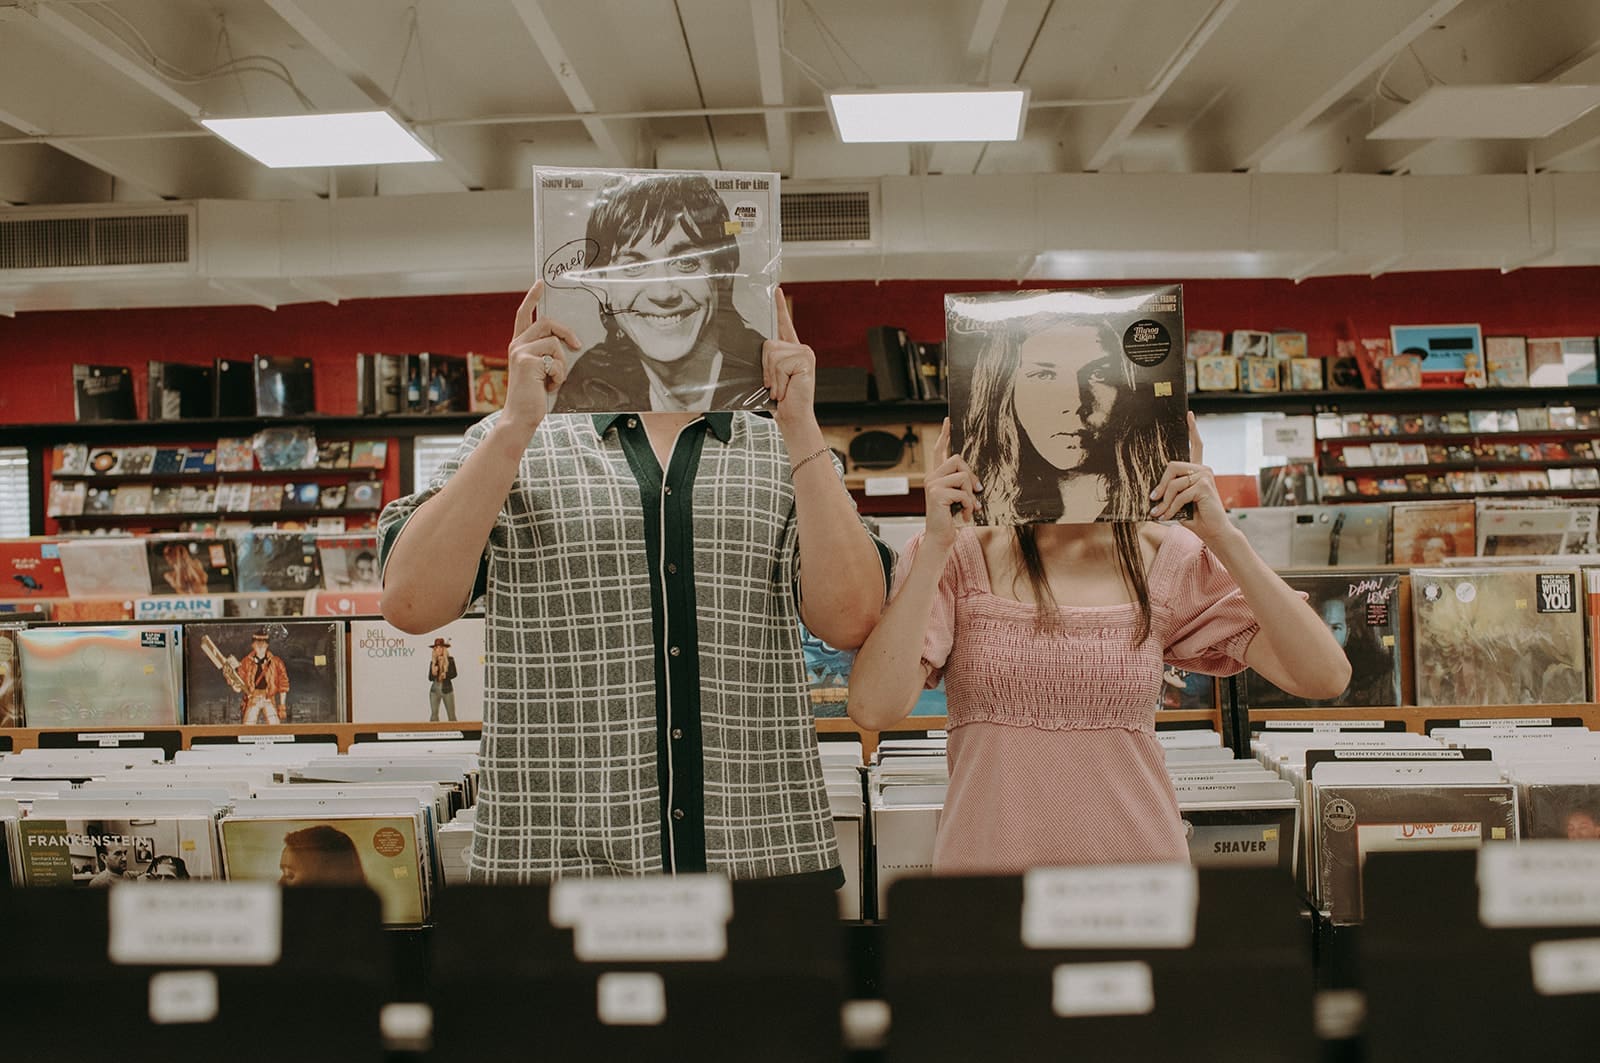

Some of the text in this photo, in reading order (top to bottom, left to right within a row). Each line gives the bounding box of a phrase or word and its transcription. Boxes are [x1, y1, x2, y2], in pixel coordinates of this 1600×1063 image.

[715, 179, 733, 190] Lust
[736, 179, 752, 190] For
[1348, 577, 1383, 598] DAMN
[1542, 583, 1570, 594] WITHIN
[140, 600, 212, 612] DRAIN
[1542, 592, 1571, 609] YOU
[366, 629, 384, 639] BELL
[359, 638, 405, 649] BOTTOM
[367, 647, 416, 658] COUNTRY
[28, 835, 148, 847] FRANKENSTEIN
[1214, 841, 1267, 854] SHAVER
